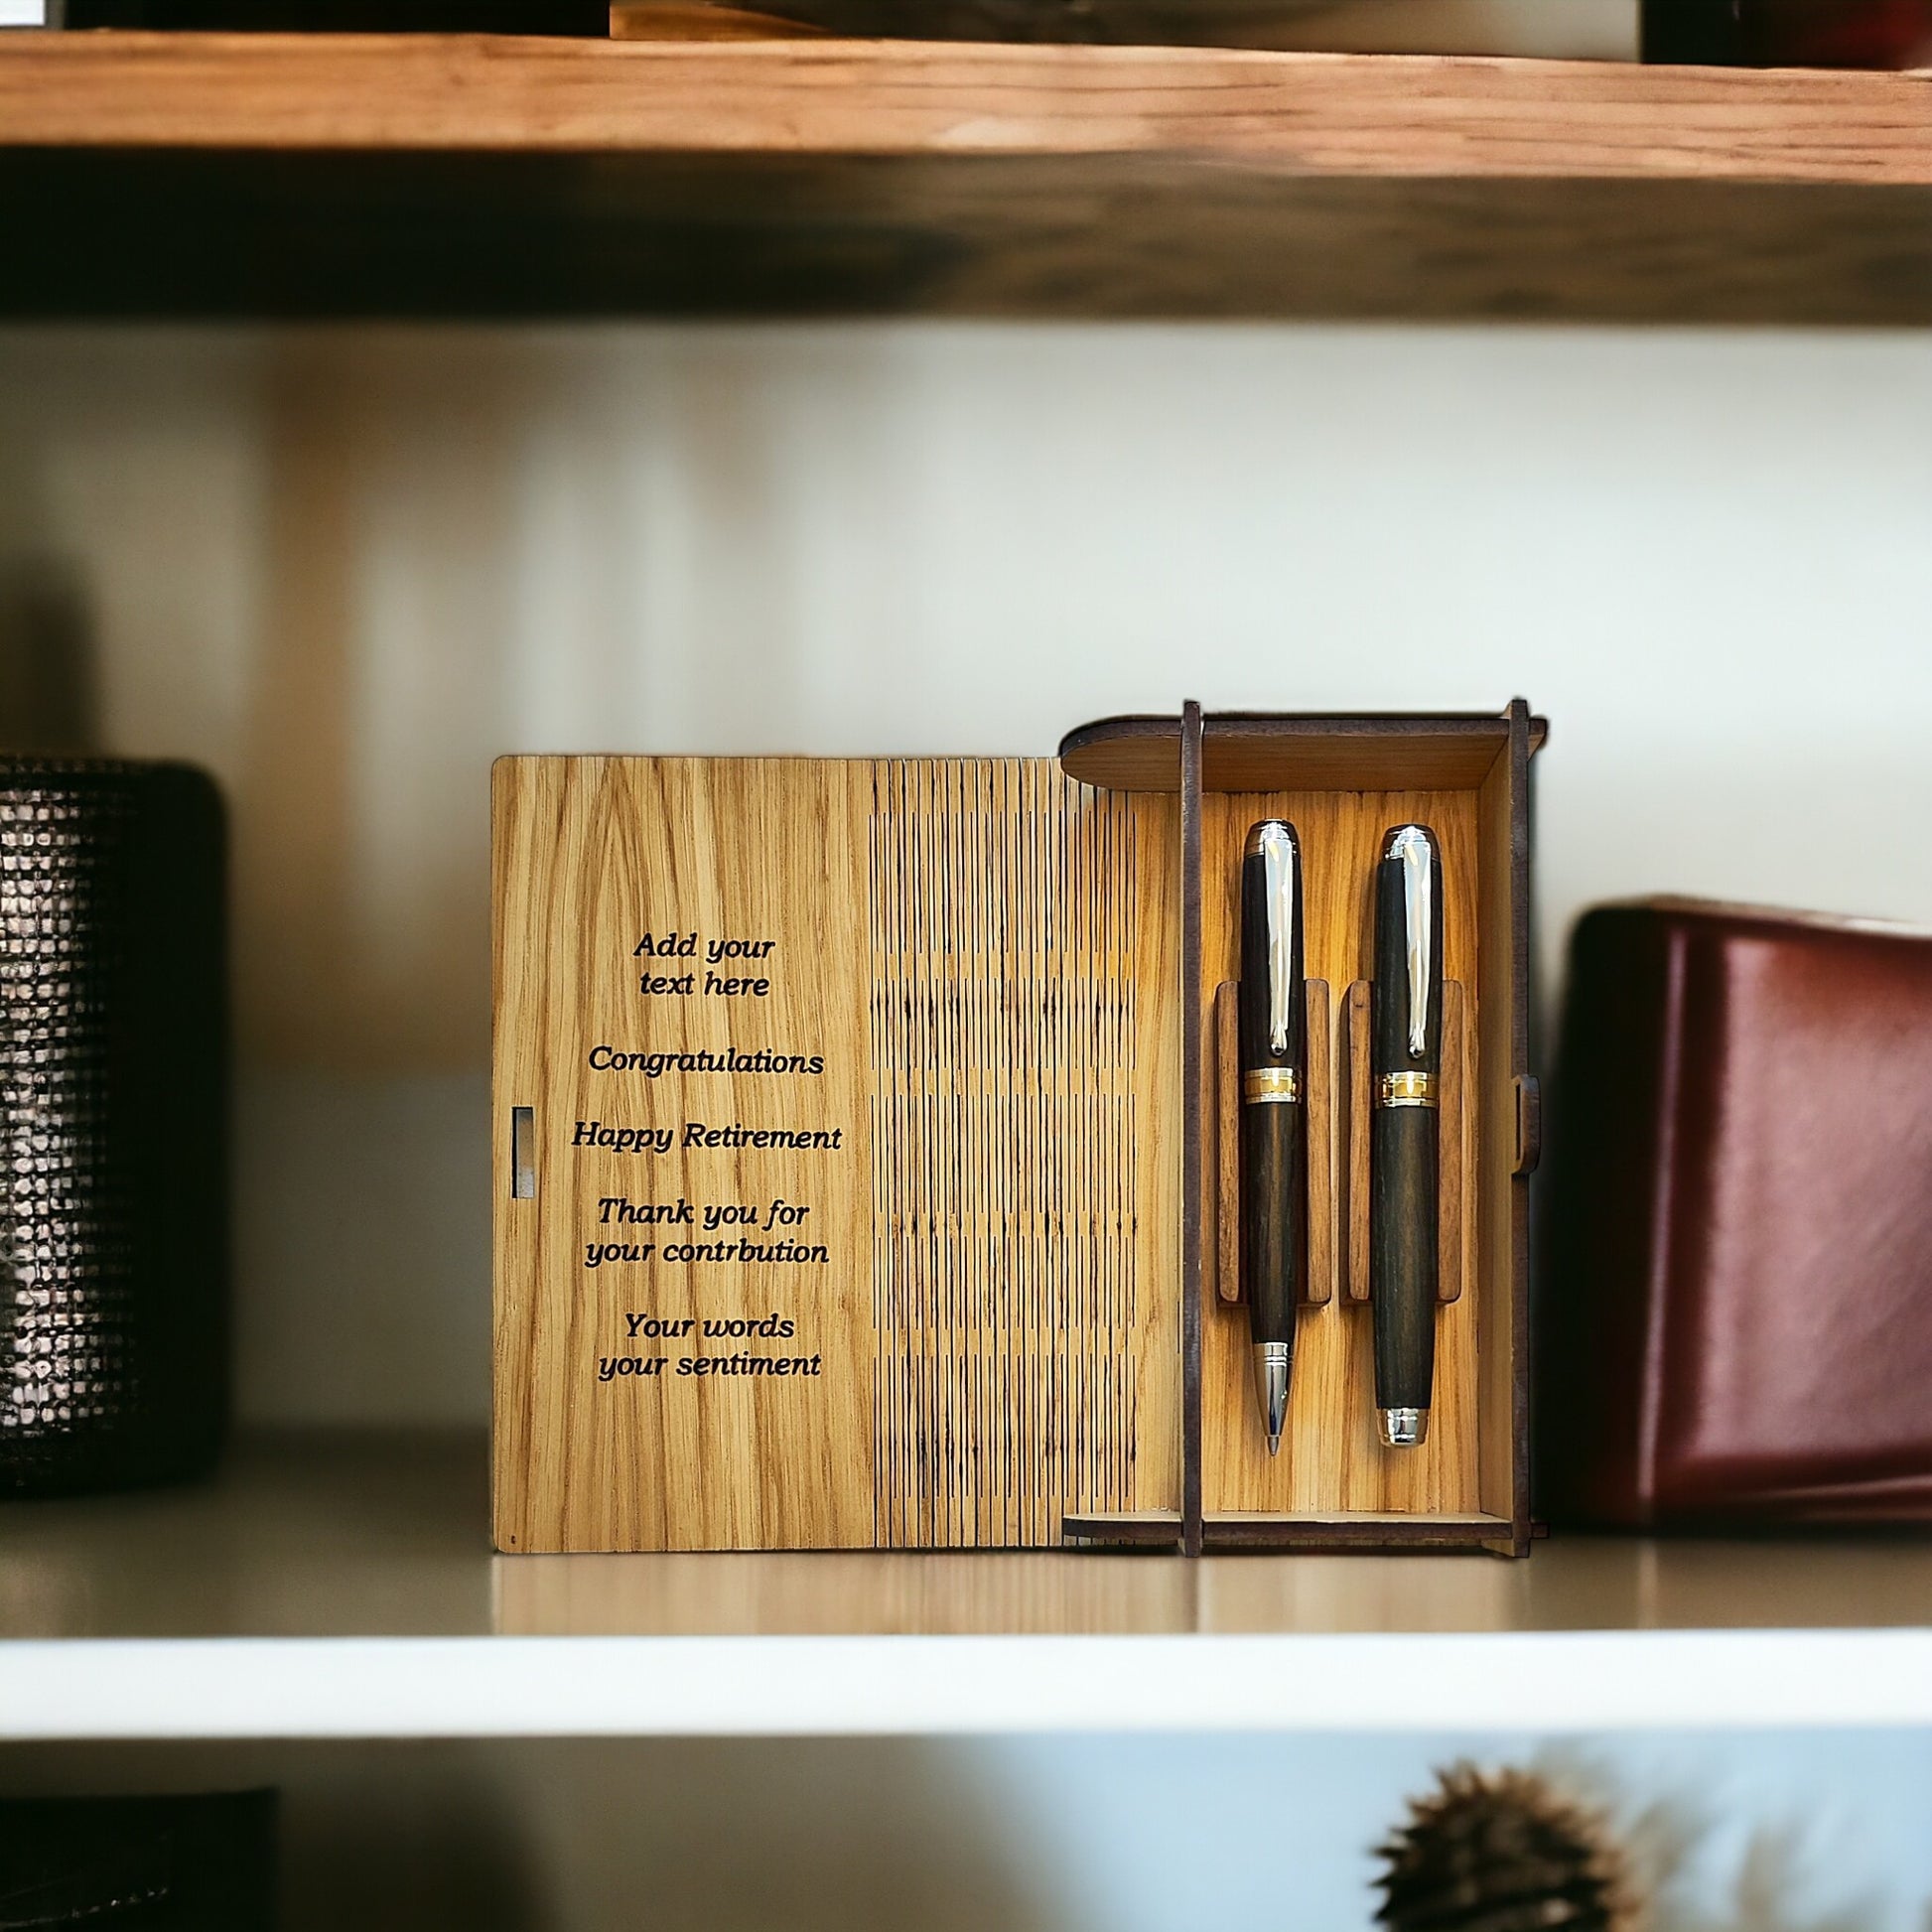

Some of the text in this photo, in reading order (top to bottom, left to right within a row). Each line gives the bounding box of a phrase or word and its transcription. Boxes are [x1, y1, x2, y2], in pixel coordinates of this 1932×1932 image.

[632, 931, 776, 964] Add your
[639, 970, 769, 997] text here
[588, 1044, 824, 1079] Congratulations
[571, 1121, 843, 1155] Happy Retirement
[598, 1197, 810, 1232] Thank you for
[584, 1237, 830, 1269] your contrbution
[624, 1312, 794, 1338] Your words
[598, 1350, 822, 1382] your sentiment
